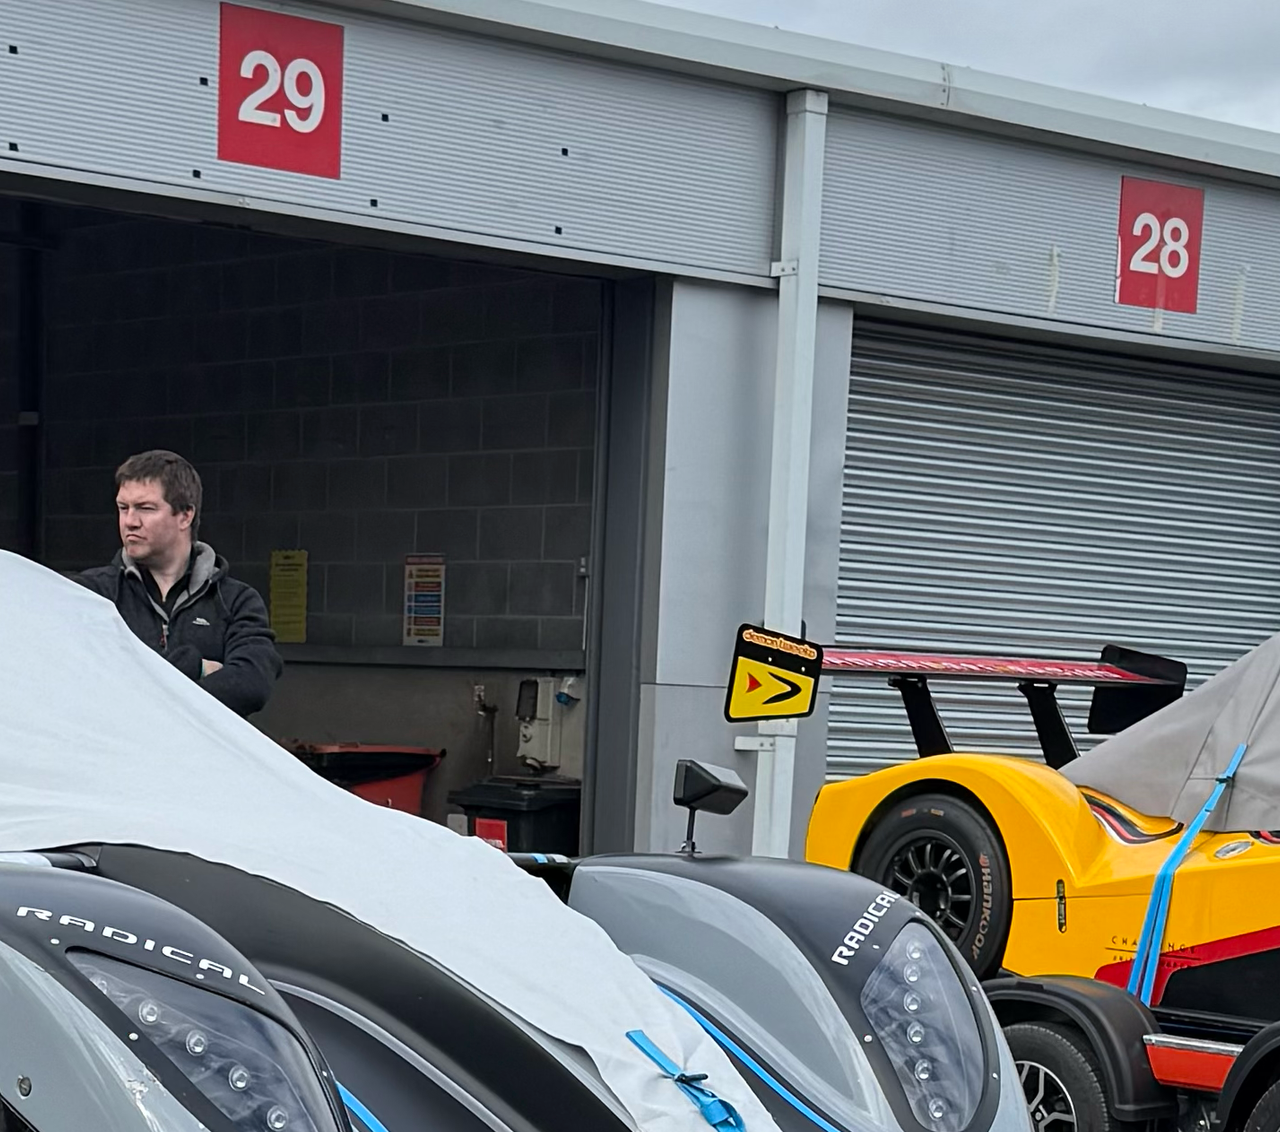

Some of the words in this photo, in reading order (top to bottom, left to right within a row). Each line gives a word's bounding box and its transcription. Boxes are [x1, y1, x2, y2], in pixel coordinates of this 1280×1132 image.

[238, 49, 326, 134] 29
[1129, 212, 1189, 279] 28
[16, 906, 266, 997] RADICAL
